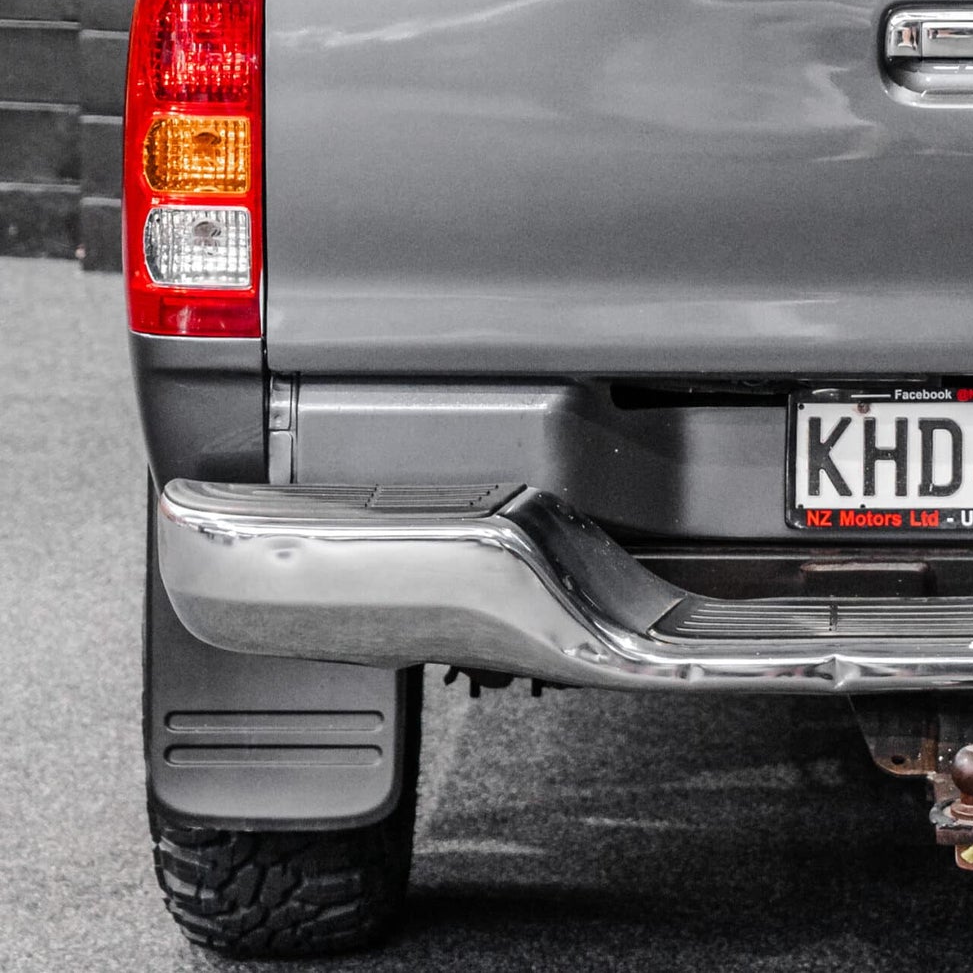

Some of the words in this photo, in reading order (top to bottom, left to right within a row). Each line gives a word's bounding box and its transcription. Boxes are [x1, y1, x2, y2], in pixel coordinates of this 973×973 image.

[894, 389, 952, 400] Facebook
[806, 510, 832, 526] NZ
[839, 510, 902, 526] Motors
[910, 510, 939, 526] Ltd
